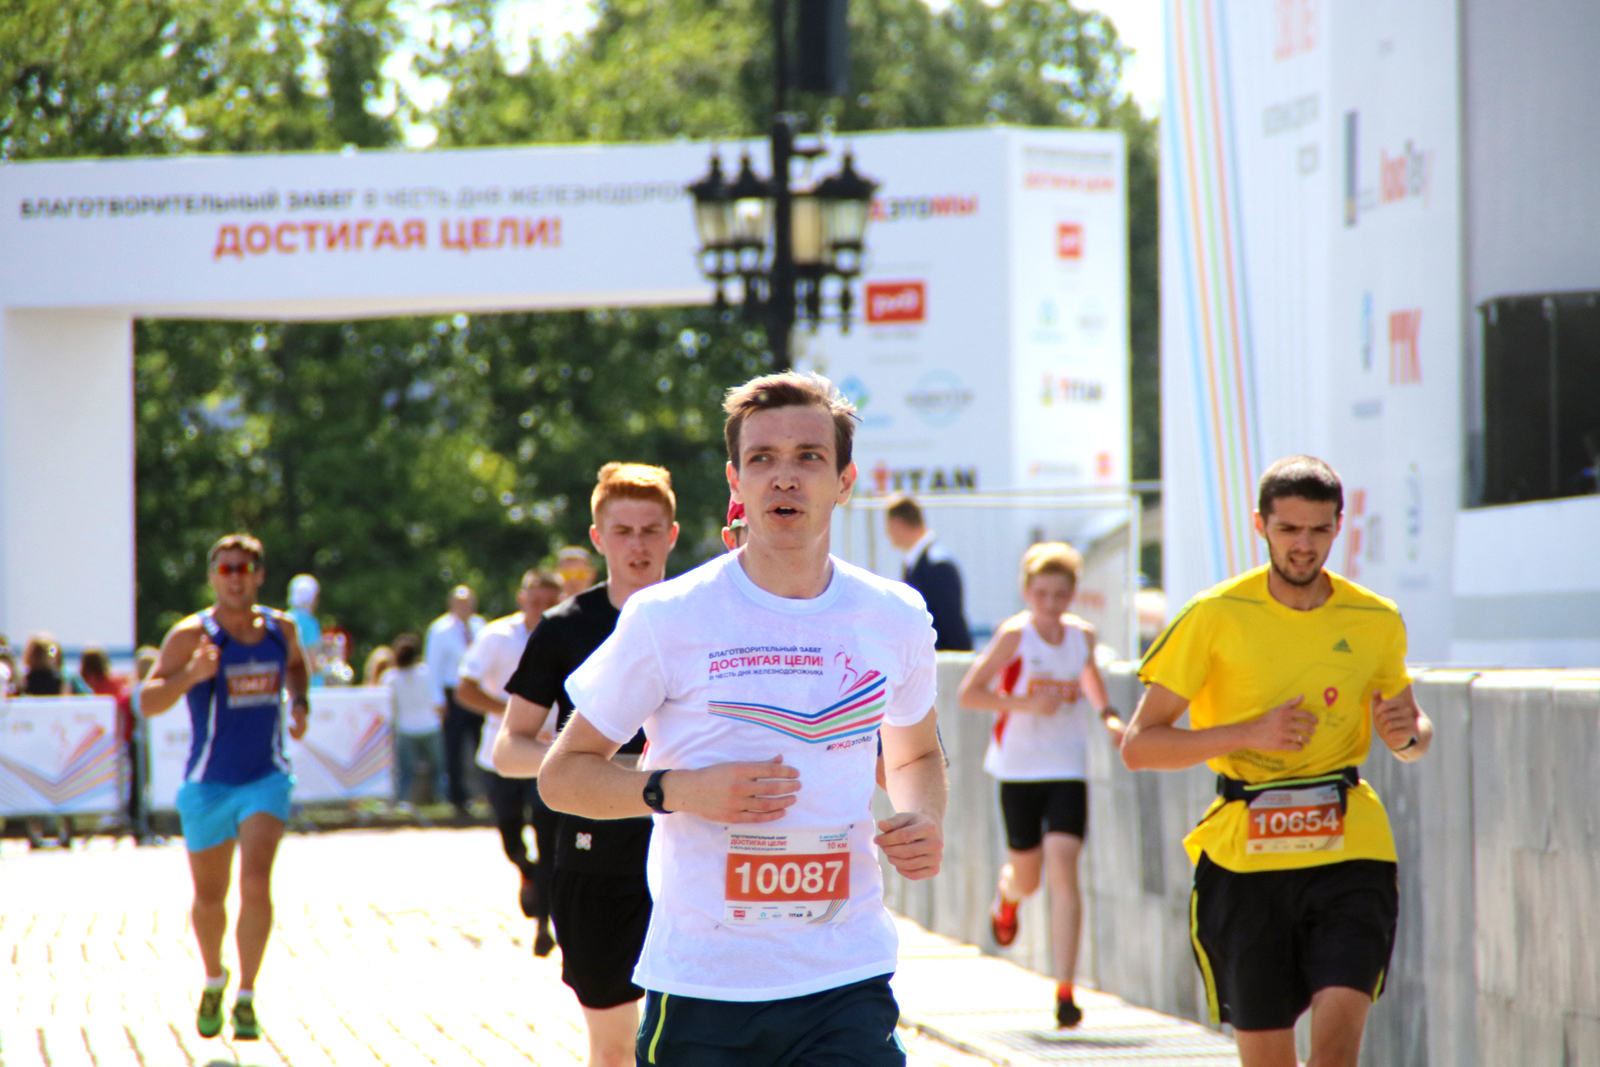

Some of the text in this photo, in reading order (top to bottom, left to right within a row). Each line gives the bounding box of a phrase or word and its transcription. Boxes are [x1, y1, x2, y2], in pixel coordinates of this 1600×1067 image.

[20, 187, 279, 219] БЛАГОТВОРИТЕЛЬНЫЙ
[287, 189, 354, 211] ЗАБЕГ
[363, 188, 378, 208] В
[384, 187, 449, 208] ЧЕСТЬ
[457, 186, 501, 208] ДНЯ
[213, 217, 563, 261] ДОСТИГАЯ ЦЕЛИ!
[870, 461, 978, 493] TITAN
[708, 645, 822, 659] БЛАГОТВОРИТЕЛЬНЫЙ ЗАБЕГ
[708, 654, 824, 674] ДОСТИГАЯ ЦЕЛИ!
[715, 671, 737, 680] ЧЕСТЬ
[737, 669, 752, 677] ДНЯ
[752, 668, 824, 676] ЖЕЛЕЗНОДОРОЖНИКА
[1254, 808, 1340, 836] 10654
[730, 838, 788, 848] ДОСТИГАЯ ЦЕЛИ!
[827, 842, 836, 850] 10
[735, 860, 844, 895] 10087
